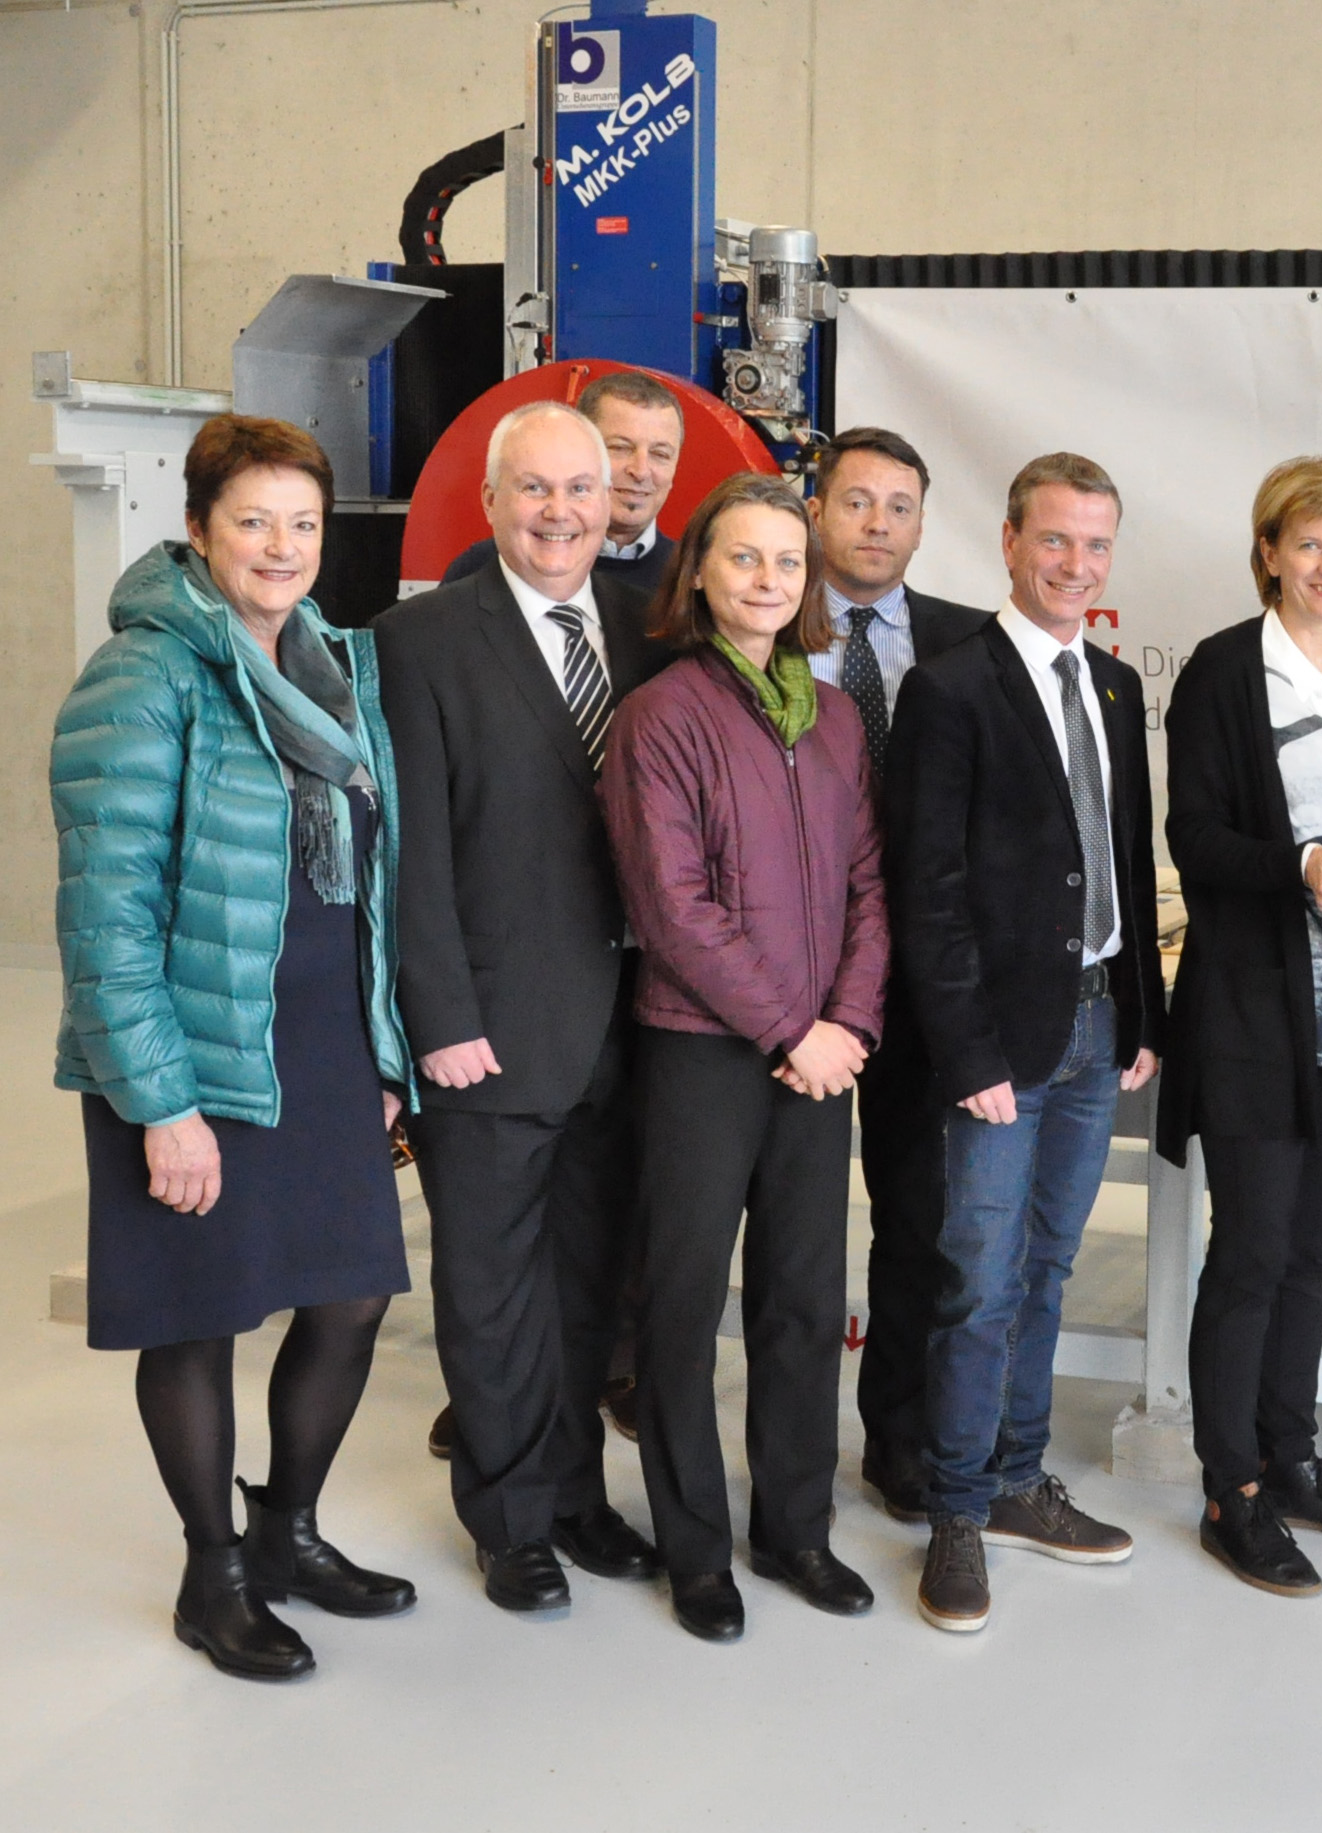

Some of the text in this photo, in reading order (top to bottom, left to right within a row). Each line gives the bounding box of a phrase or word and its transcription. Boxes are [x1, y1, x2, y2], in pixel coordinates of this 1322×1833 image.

[556, 53, 695, 186] M. KOLB
[557, 91, 619, 103] Dr. Baumann
[573, 104, 691, 208] MKK-Plus
